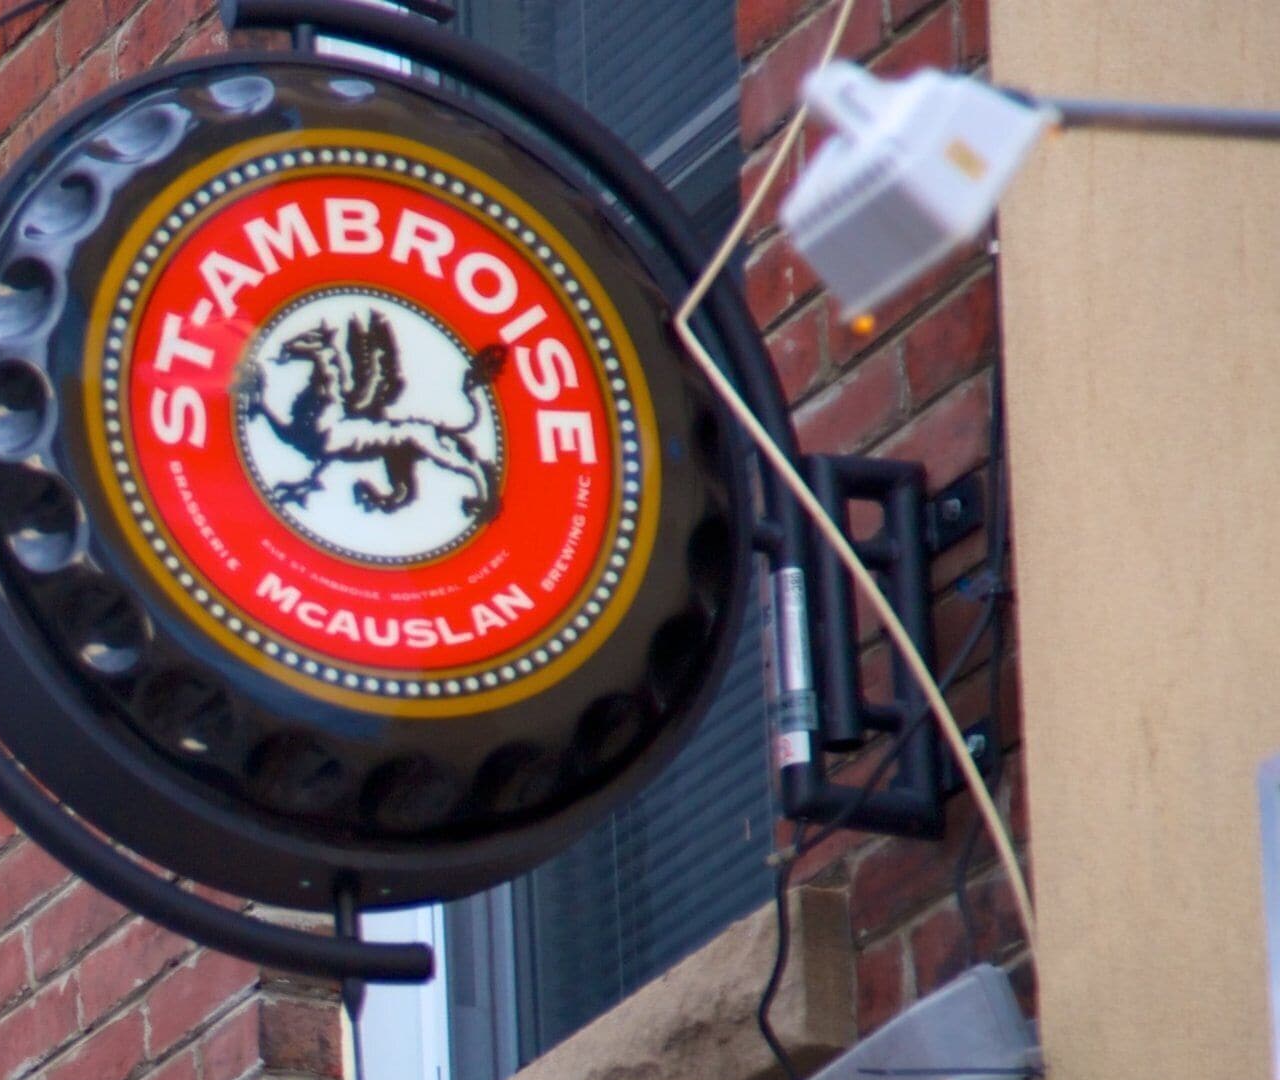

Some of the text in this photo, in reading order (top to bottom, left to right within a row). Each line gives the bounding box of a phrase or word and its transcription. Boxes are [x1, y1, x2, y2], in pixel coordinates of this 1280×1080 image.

[150, 197, 598, 465] ST-AMBROISE
[169, 460, 240, 571] BRASSERIE
[541, 514, 587, 592] BREWING
[576, 475, 591, 509] INC
